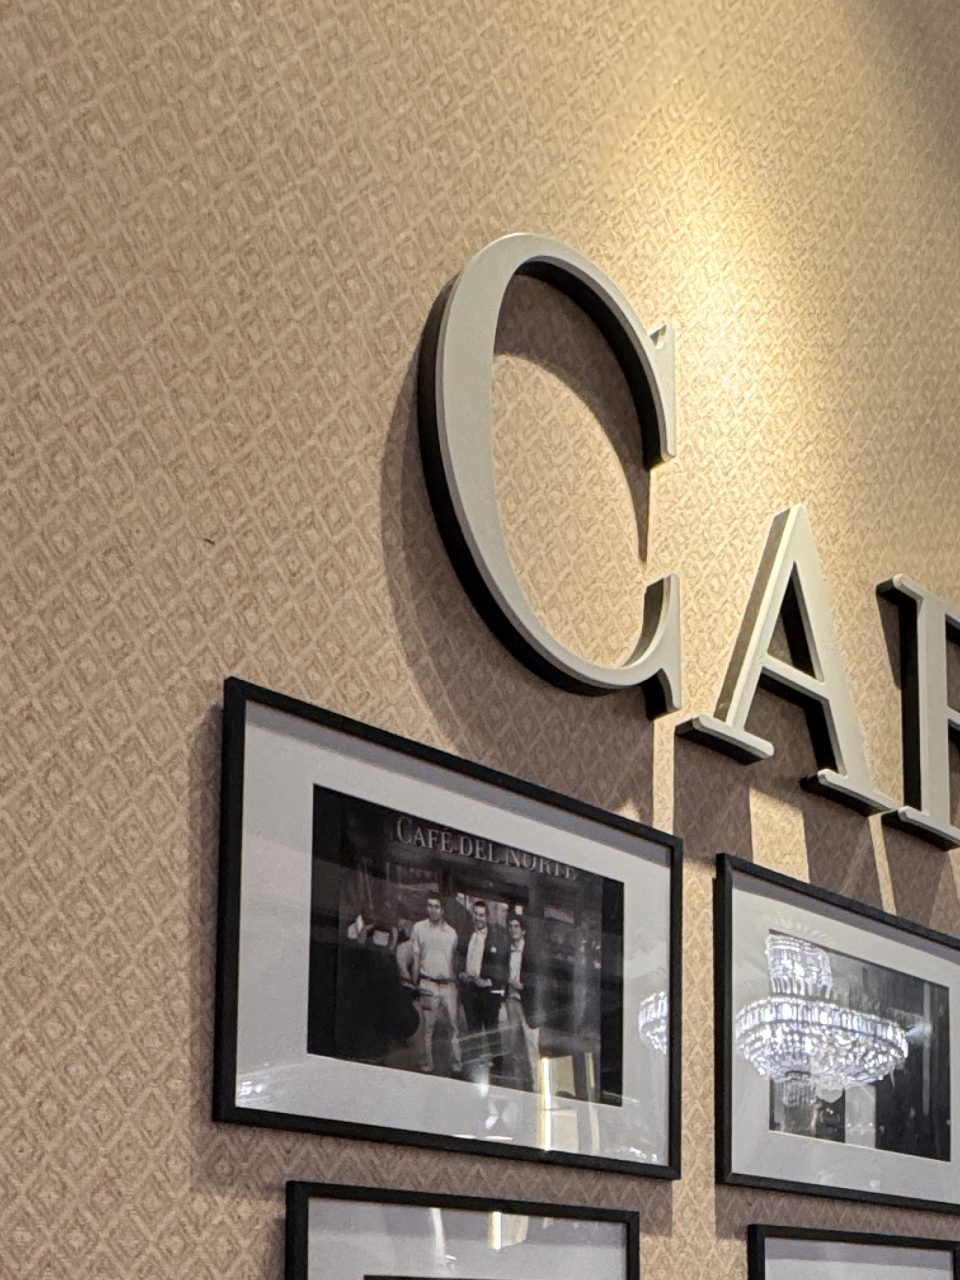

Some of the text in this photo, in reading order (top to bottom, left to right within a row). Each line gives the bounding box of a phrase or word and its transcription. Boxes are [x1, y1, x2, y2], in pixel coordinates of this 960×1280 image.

[397, 816, 578, 881] CAFÉ DEL NORTE
